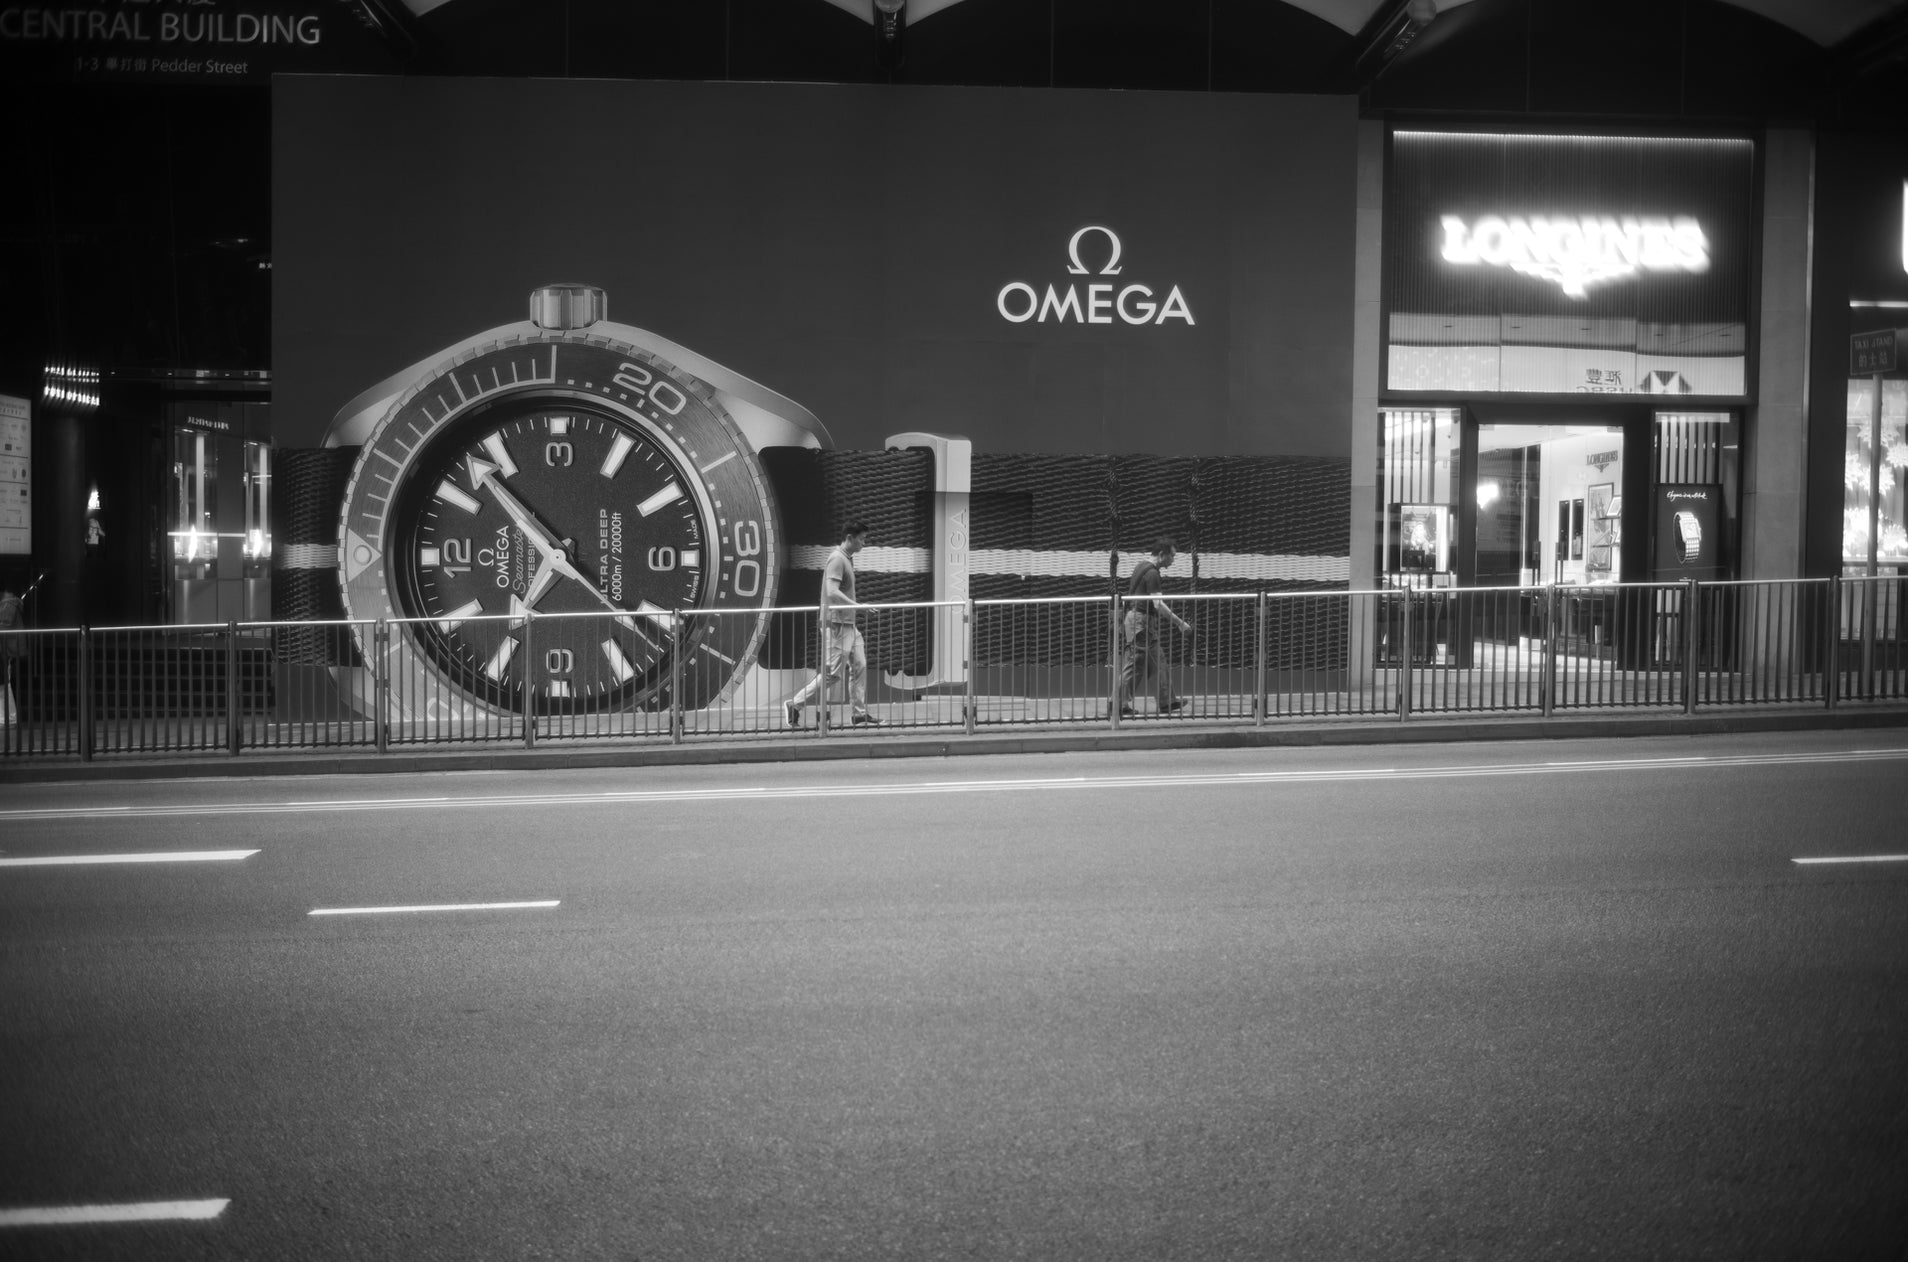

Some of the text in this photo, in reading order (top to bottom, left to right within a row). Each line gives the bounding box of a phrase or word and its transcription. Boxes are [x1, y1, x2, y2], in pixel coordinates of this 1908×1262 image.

[0, 8, 321, 44] CENTRAL BUILDING
[152, 58, 201, 73] Pedder
[206, 60, 248, 74] Street
[1440, 214, 1710, 273] LONGINES
[997, 281, 1196, 326] OMEGA
[612, 362, 687, 416] 20
[545, 441, 574, 467] 3
[600, 508, 608, 549] DEEP
[611, 511, 622, 554] 20000ft
[443, 538, 472, 579] 12
[496, 525, 510, 588] OMEGA
[512, 523, 526, 594] Seamaste
[648, 546, 676, 572] 6
[734, 520, 761, 597] 30
[612, 565, 622, 601] 6000m
[545, 648, 574, 674] 9
